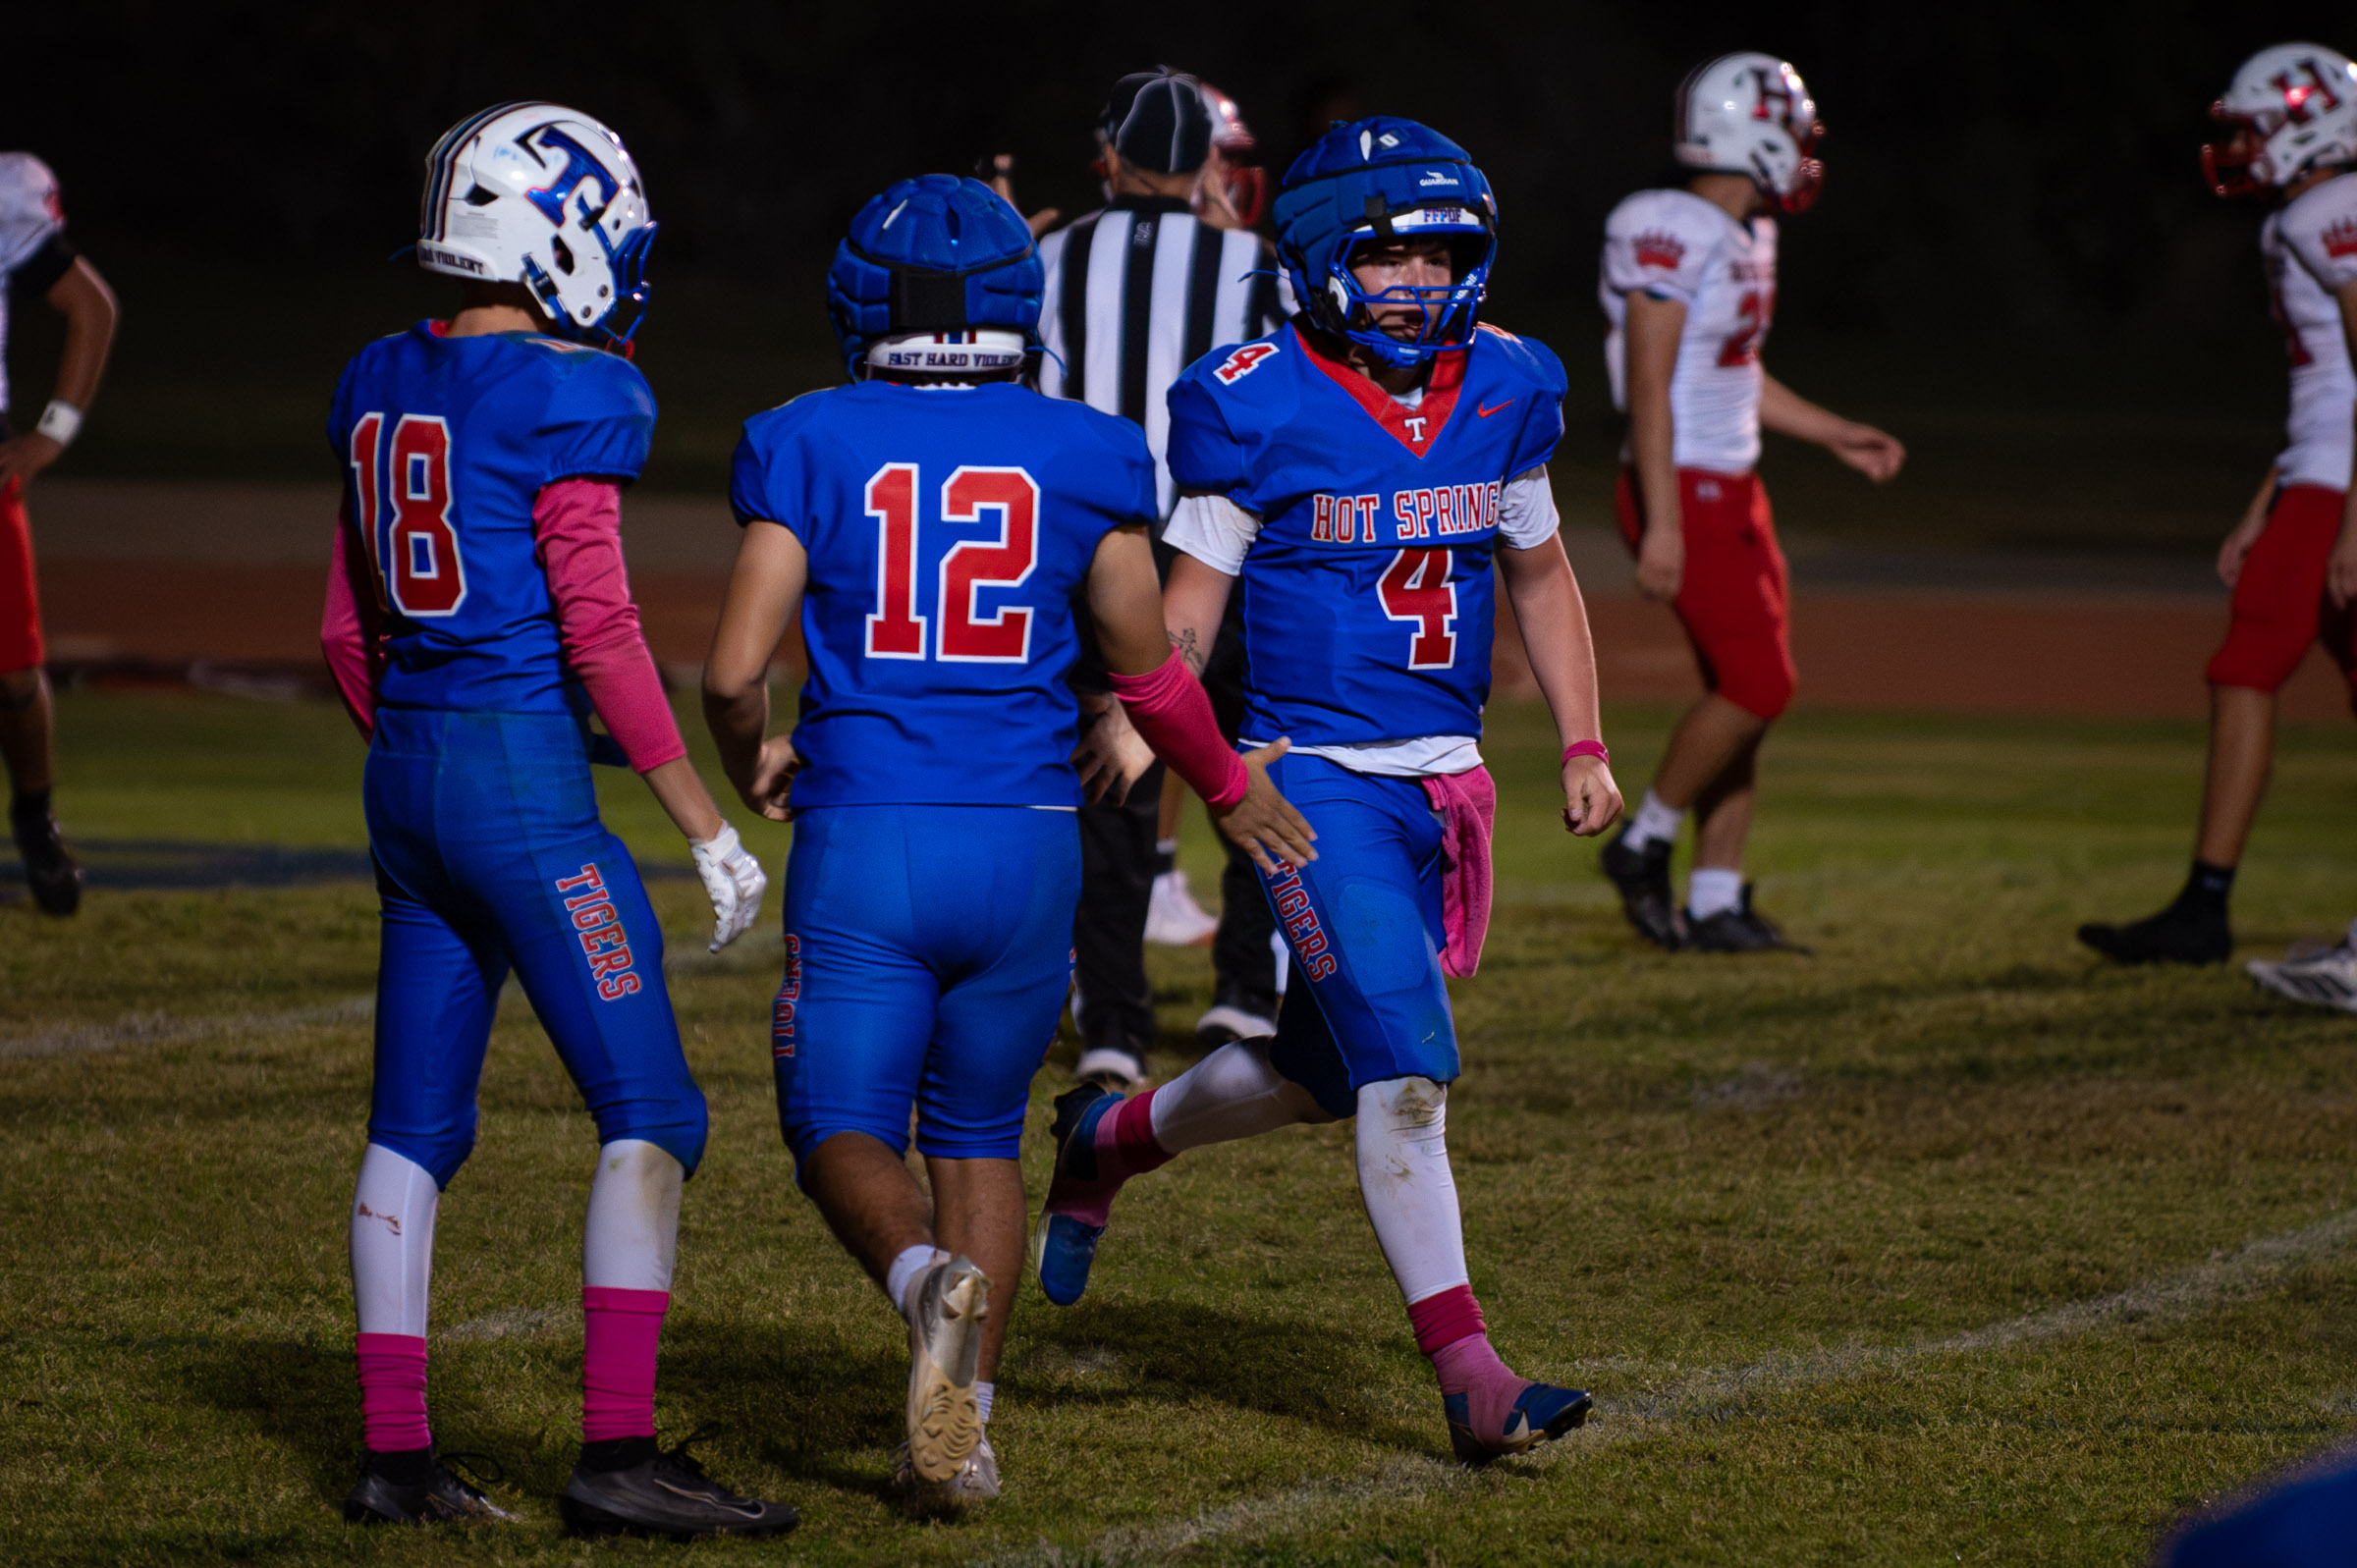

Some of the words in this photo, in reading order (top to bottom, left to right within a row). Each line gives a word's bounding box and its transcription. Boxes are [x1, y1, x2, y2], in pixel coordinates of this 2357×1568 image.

[524, 124, 621, 229] T
[888, 352, 922, 366] FAST
[925, 353, 969, 367] HARD
[1213, 342, 1280, 386] 4
[1403, 416, 1427, 442] T
[350, 410, 468, 617] 18
[864, 461, 1041, 664] 12
[1311, 493, 1380, 543] HOT
[1393, 481, 1500, 540] SPRING
[1376, 546, 1457, 671] 4
[555, 862, 641, 1001] TIGERS
